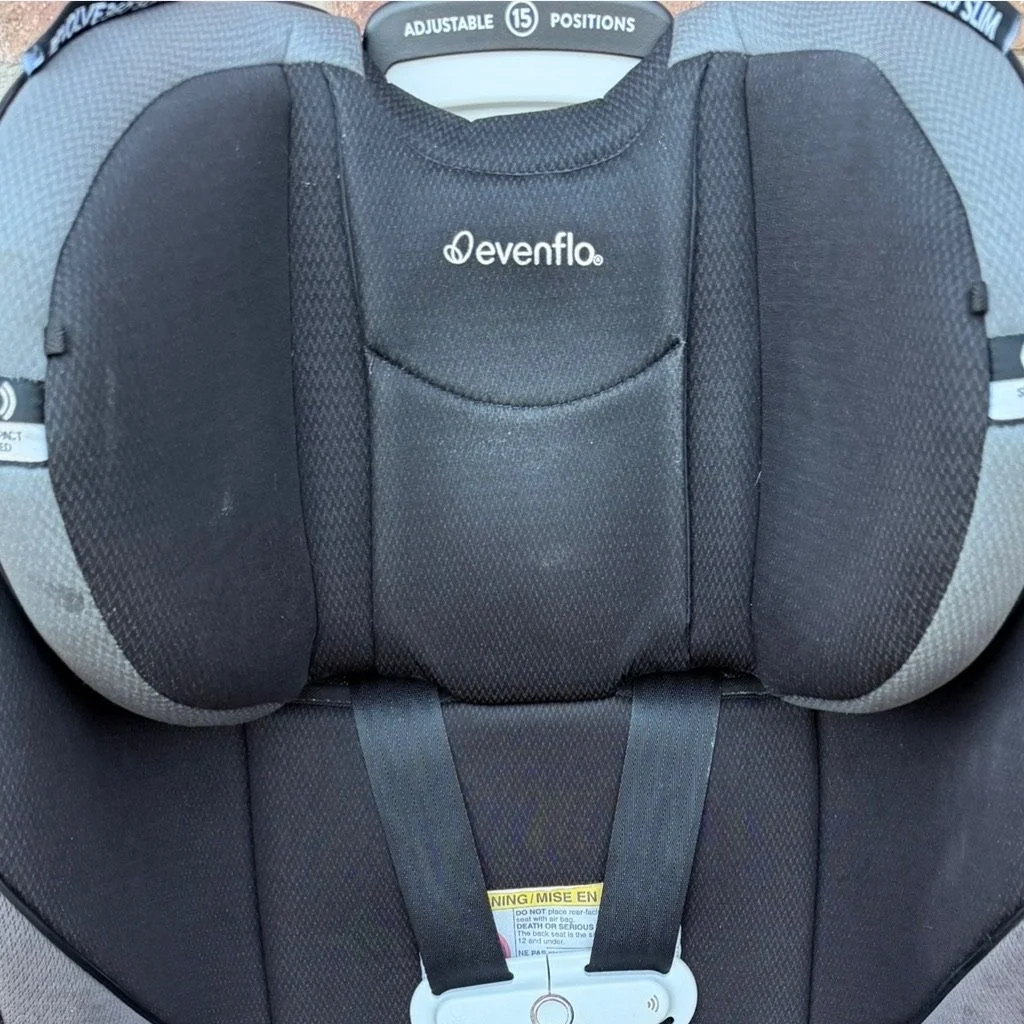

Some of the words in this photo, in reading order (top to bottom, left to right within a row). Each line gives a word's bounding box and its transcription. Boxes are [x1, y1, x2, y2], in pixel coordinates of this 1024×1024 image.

[404, 14, 494, 37] ADJUSTABLE
[511, 8, 532, 28] 15
[551, 14, 635, 33] POSITIONS
[576, 890, 598, 903] EN
[558, 923, 594, 931] SERIOUS
